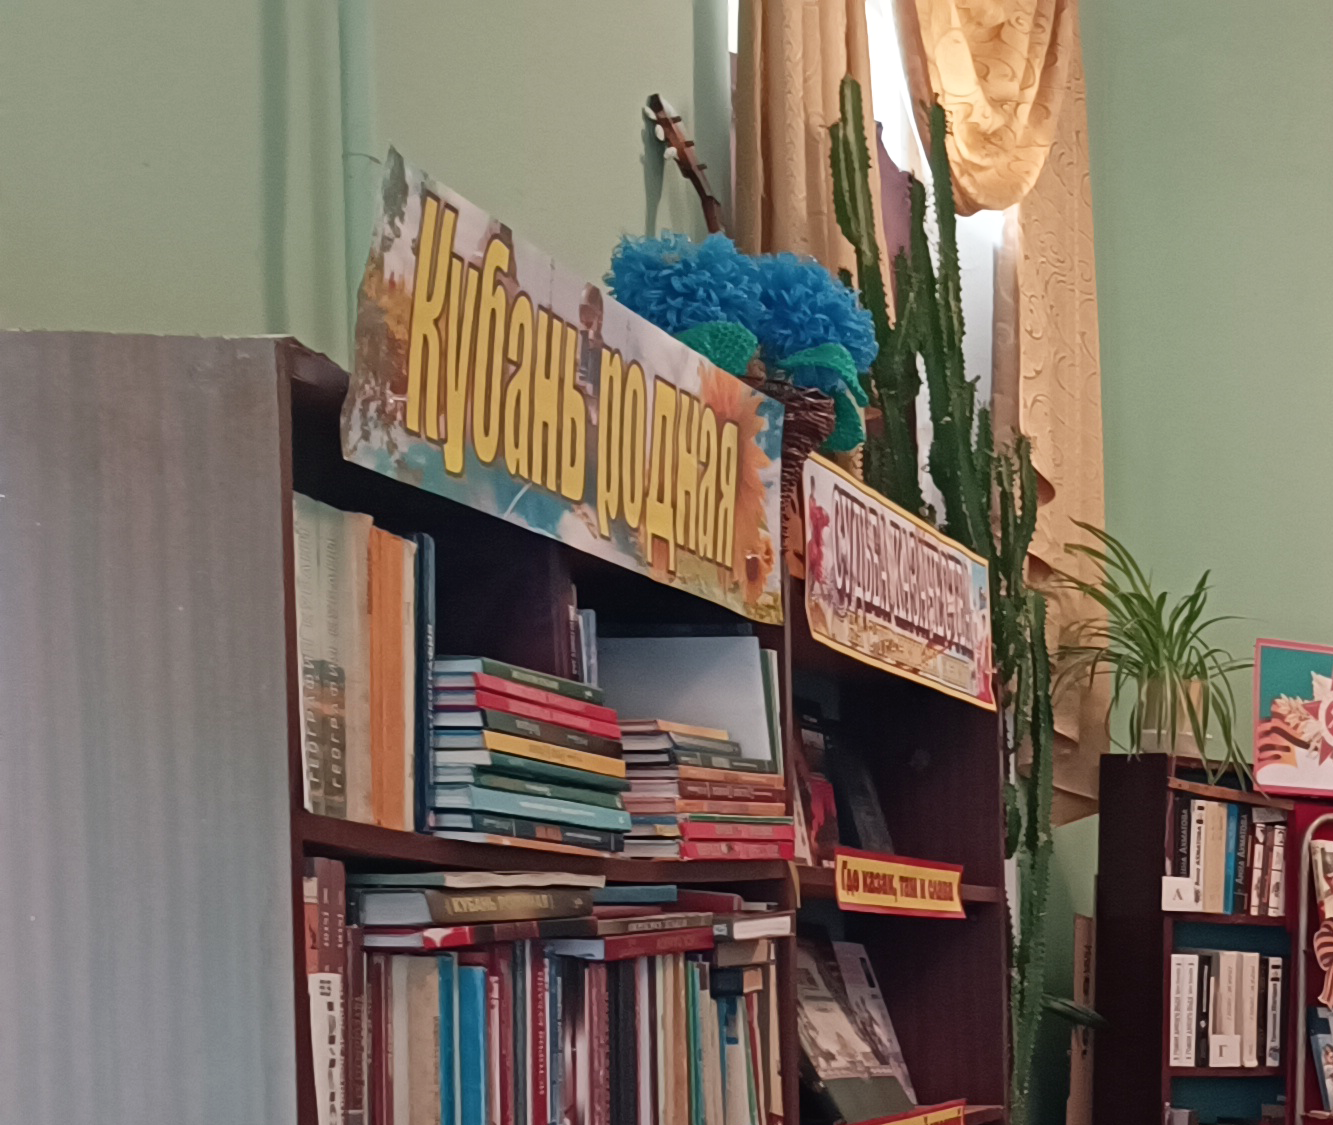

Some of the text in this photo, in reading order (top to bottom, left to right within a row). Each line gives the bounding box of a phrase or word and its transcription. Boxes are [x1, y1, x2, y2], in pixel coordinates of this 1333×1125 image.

[406, 197, 741, 575] Кубань родная
[1180, 809, 1188, 856] АХМАТОВА
